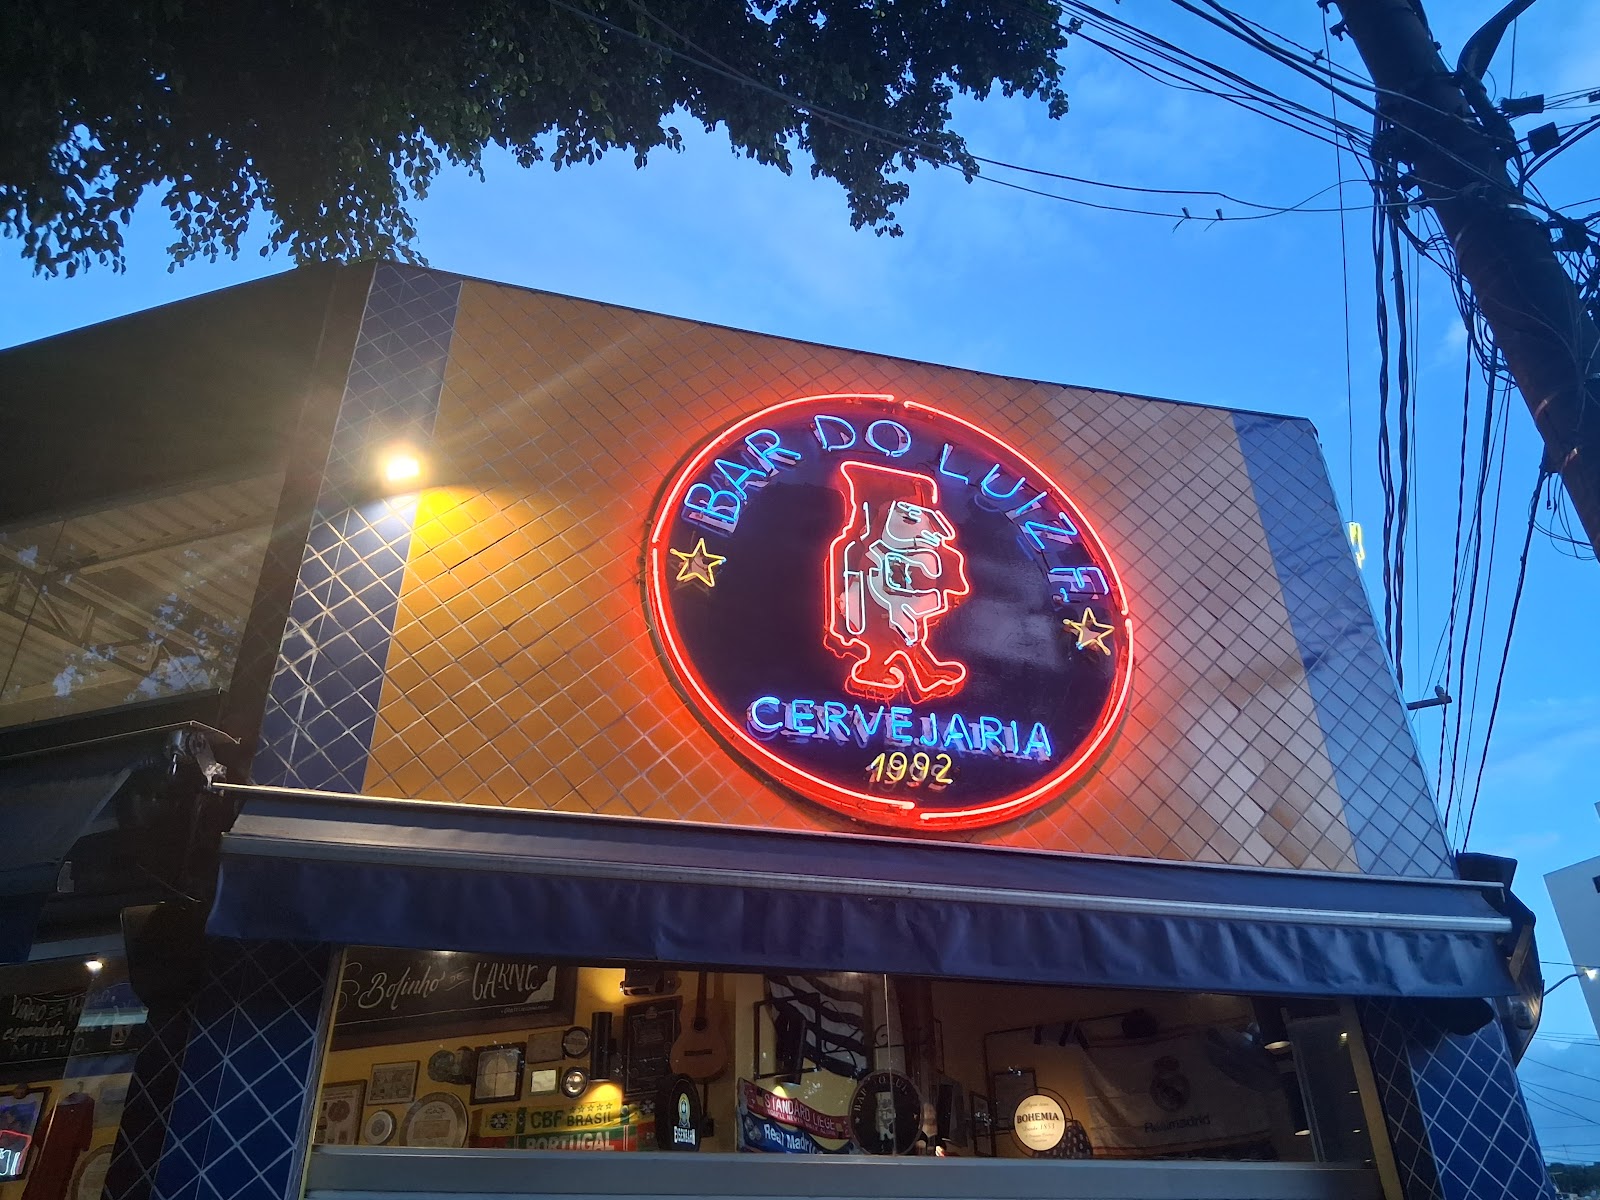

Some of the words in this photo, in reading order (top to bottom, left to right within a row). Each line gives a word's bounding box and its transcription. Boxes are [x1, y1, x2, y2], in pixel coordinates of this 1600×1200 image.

[683, 428, 801, 525] BAR
[813, 415, 912, 457] DO
[937, 443, 1079, 551] LUIZ
[750, 695, 1053, 758] CERVEJARIA
[868, 751, 954, 784] 1992
[529, 1109, 565, 1130] CBF
[566, 1111, 615, 1127] BRASIL
[764, 1093, 811, 1122] STANDARD
[1016, 1112, 1060, 1124] BOHEMIA
[525, 1131, 615, 1151] PORTUGAL
[763, 1123, 785, 1146] Real
